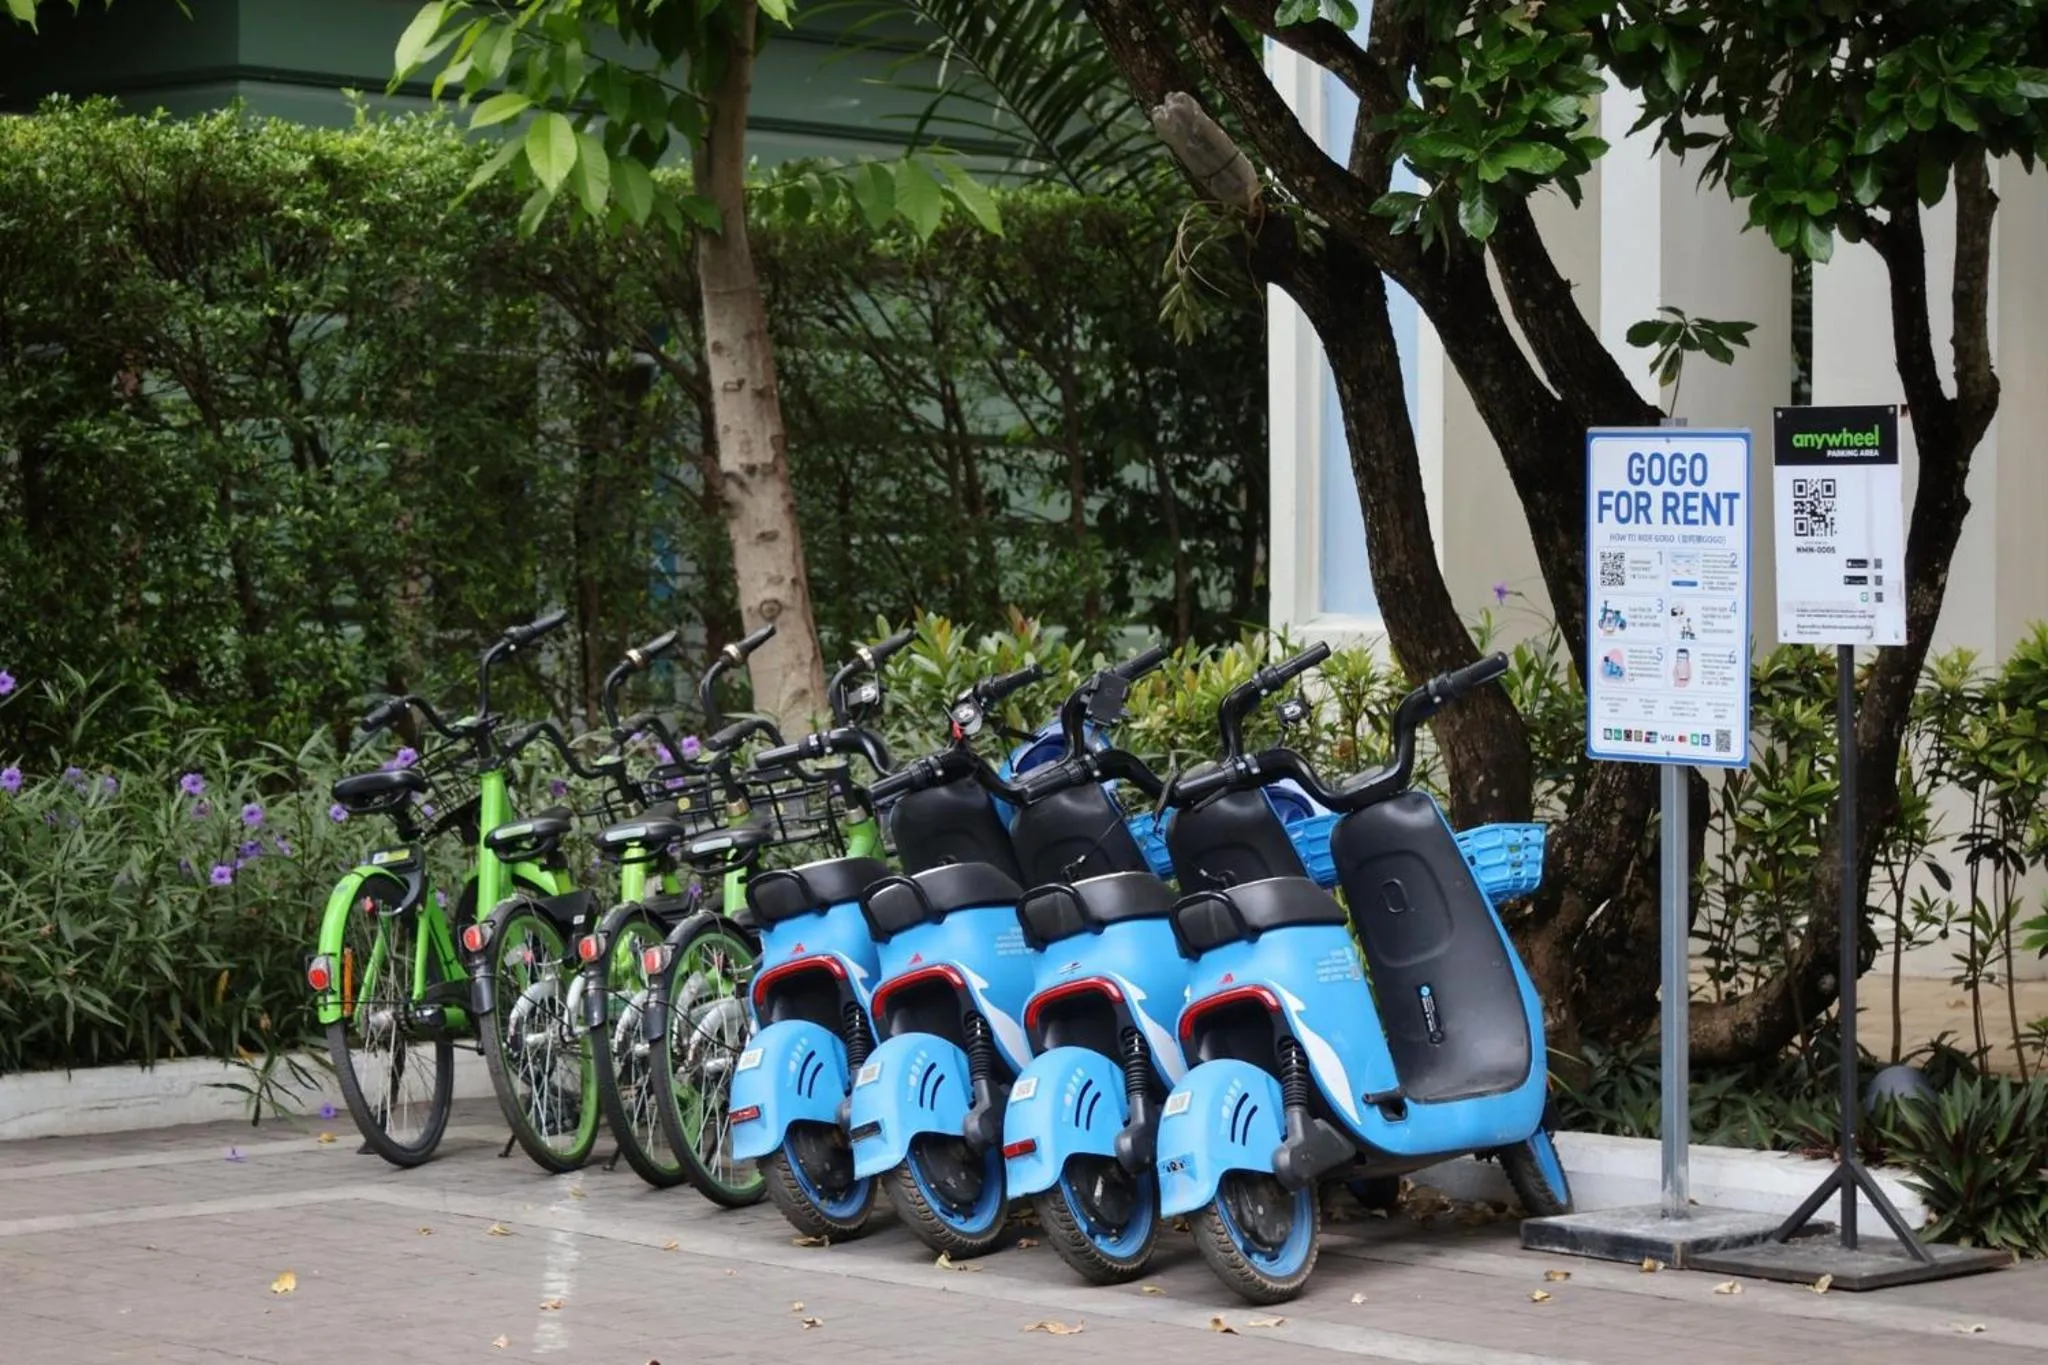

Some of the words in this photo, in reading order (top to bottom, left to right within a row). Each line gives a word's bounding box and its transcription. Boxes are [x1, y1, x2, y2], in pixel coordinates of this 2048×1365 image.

[1792, 424, 1879, 450] anywheel
[1826, 449, 1859, 457] PARKING
[1859, 449, 1879, 457] AREA
[1627, 452, 1708, 487] GOGO
[1597, 490, 1653, 525] FOR
[1662, 491, 1741, 526] RENT
[1609, 533, 1627, 542] HOW
[1628, 533, 1636, 542] TO
[1657, 551, 1663, 565] 1
[1729, 552, 1738, 568] 2
[1656, 598, 1664, 613] 3
[1728, 601, 1737, 615] 4
[1655, 647, 1664, 662] 5
[1728, 650, 1737, 664] 6
